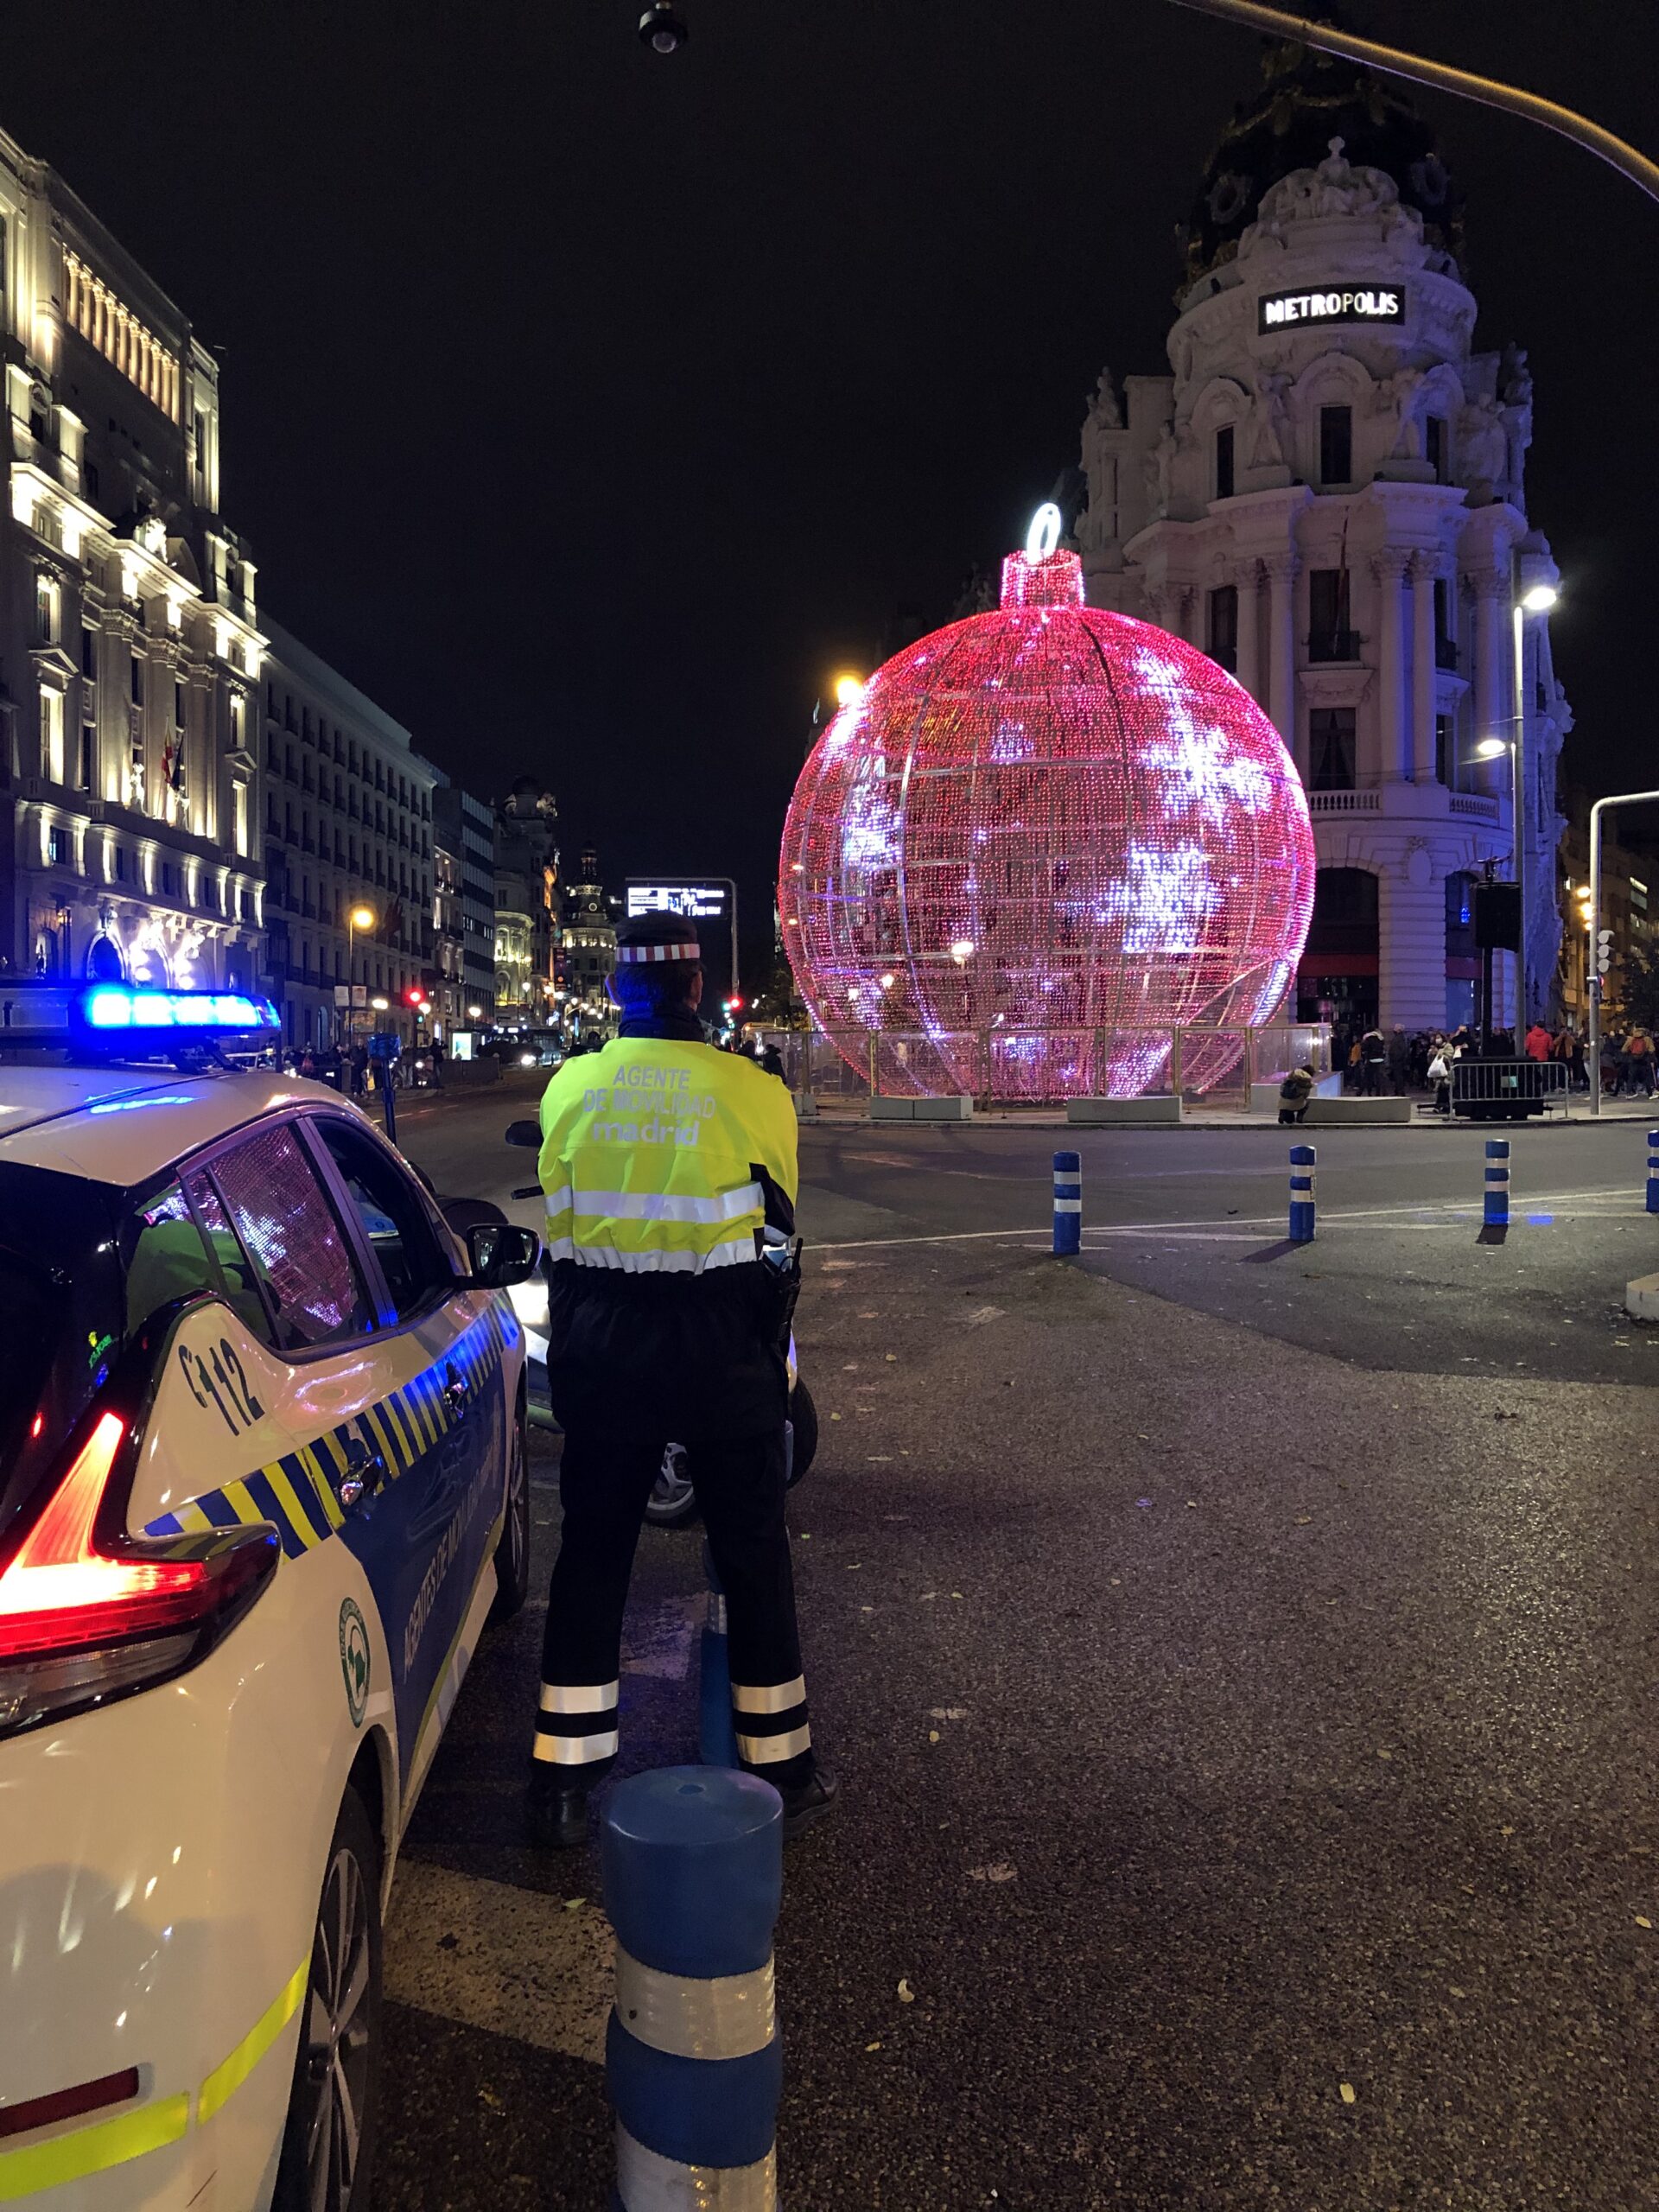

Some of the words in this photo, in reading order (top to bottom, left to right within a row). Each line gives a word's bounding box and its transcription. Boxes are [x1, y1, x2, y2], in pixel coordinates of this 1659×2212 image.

[1265, 291, 1398, 324] METROPOLIS
[612, 1065, 690, 1090] AGENTE
[583, 1088, 607, 1112] DE
[613, 1090, 716, 1119] MOVILIDAD
[593, 1118, 700, 1146] madrid
[403, 1556, 436, 1683] AGENTES
